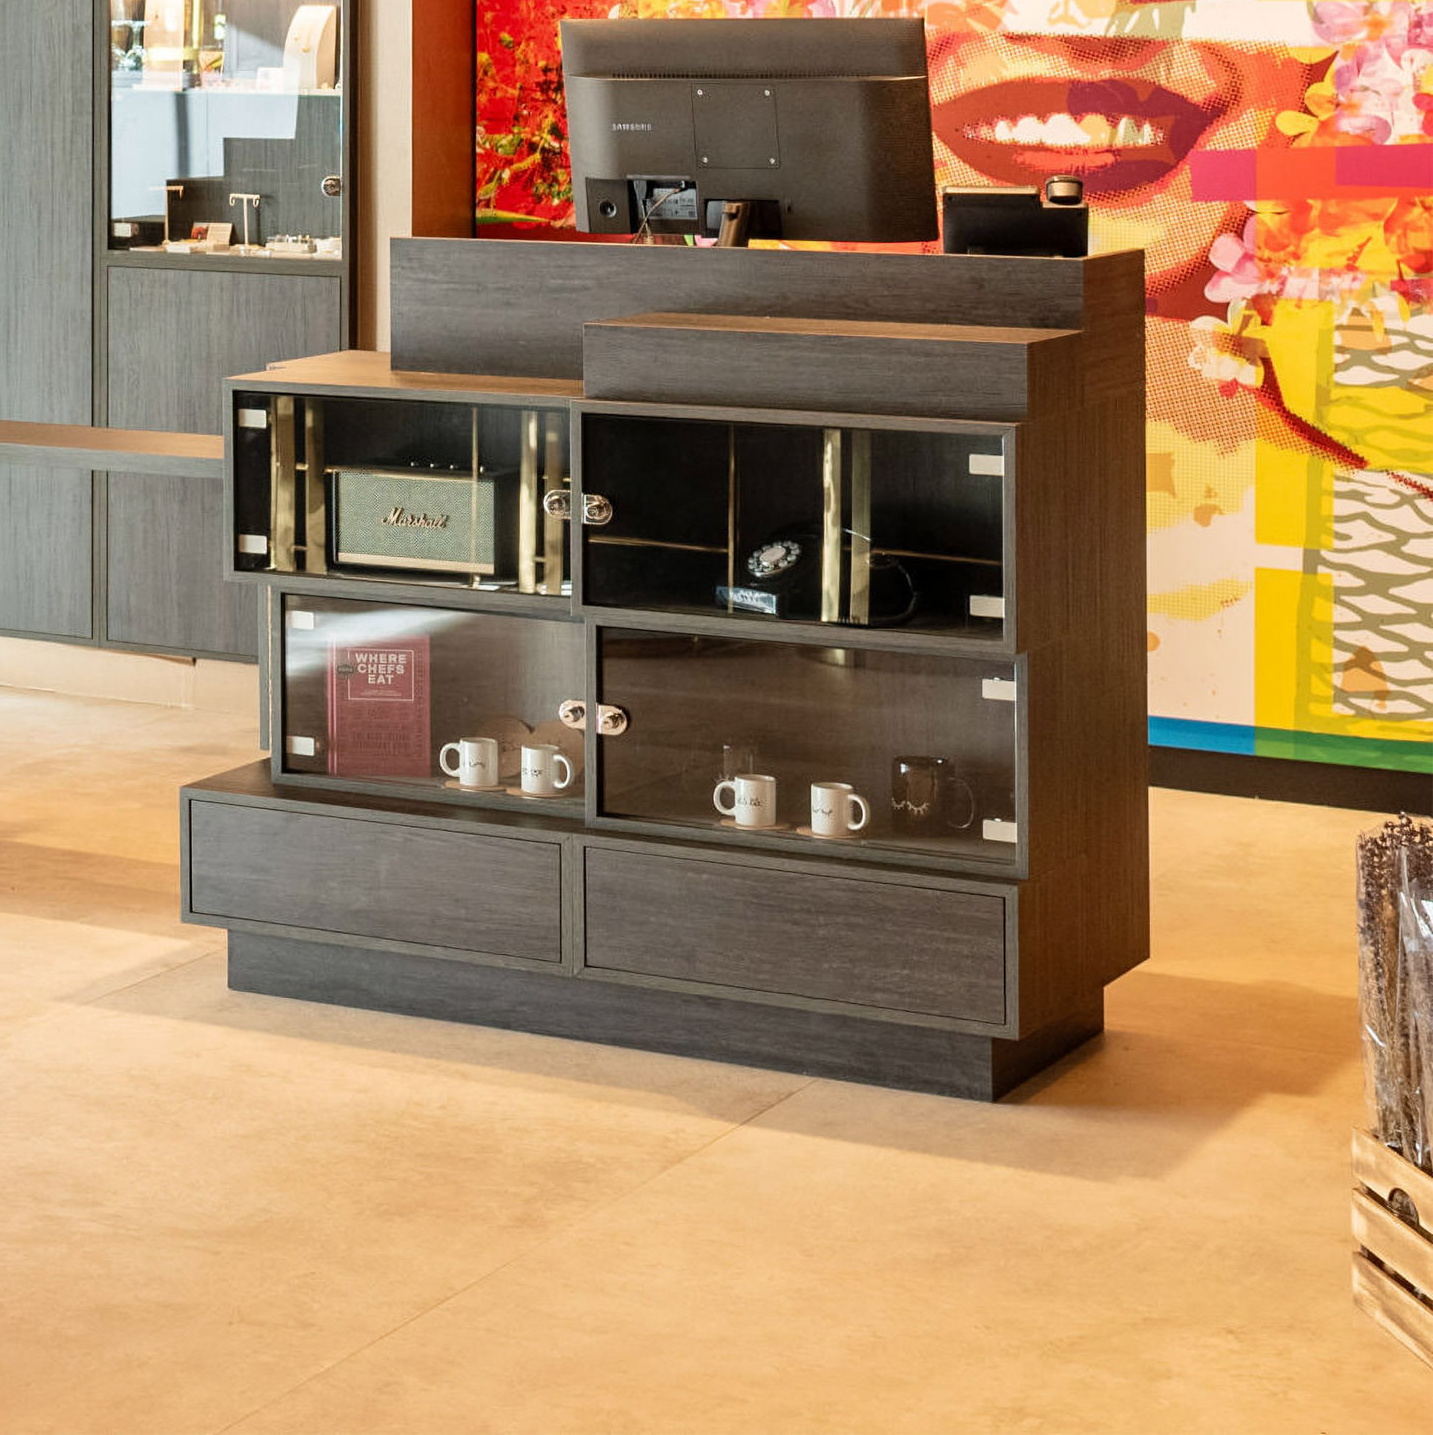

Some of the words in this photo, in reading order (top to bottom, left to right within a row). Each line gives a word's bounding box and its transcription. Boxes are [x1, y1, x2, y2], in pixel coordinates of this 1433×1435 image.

[381, 506, 450, 529] Marshall
[355, 652, 408, 665] WHERE
[356, 663, 406, 675] CHEFS
[367, 674, 395, 685] EAT
